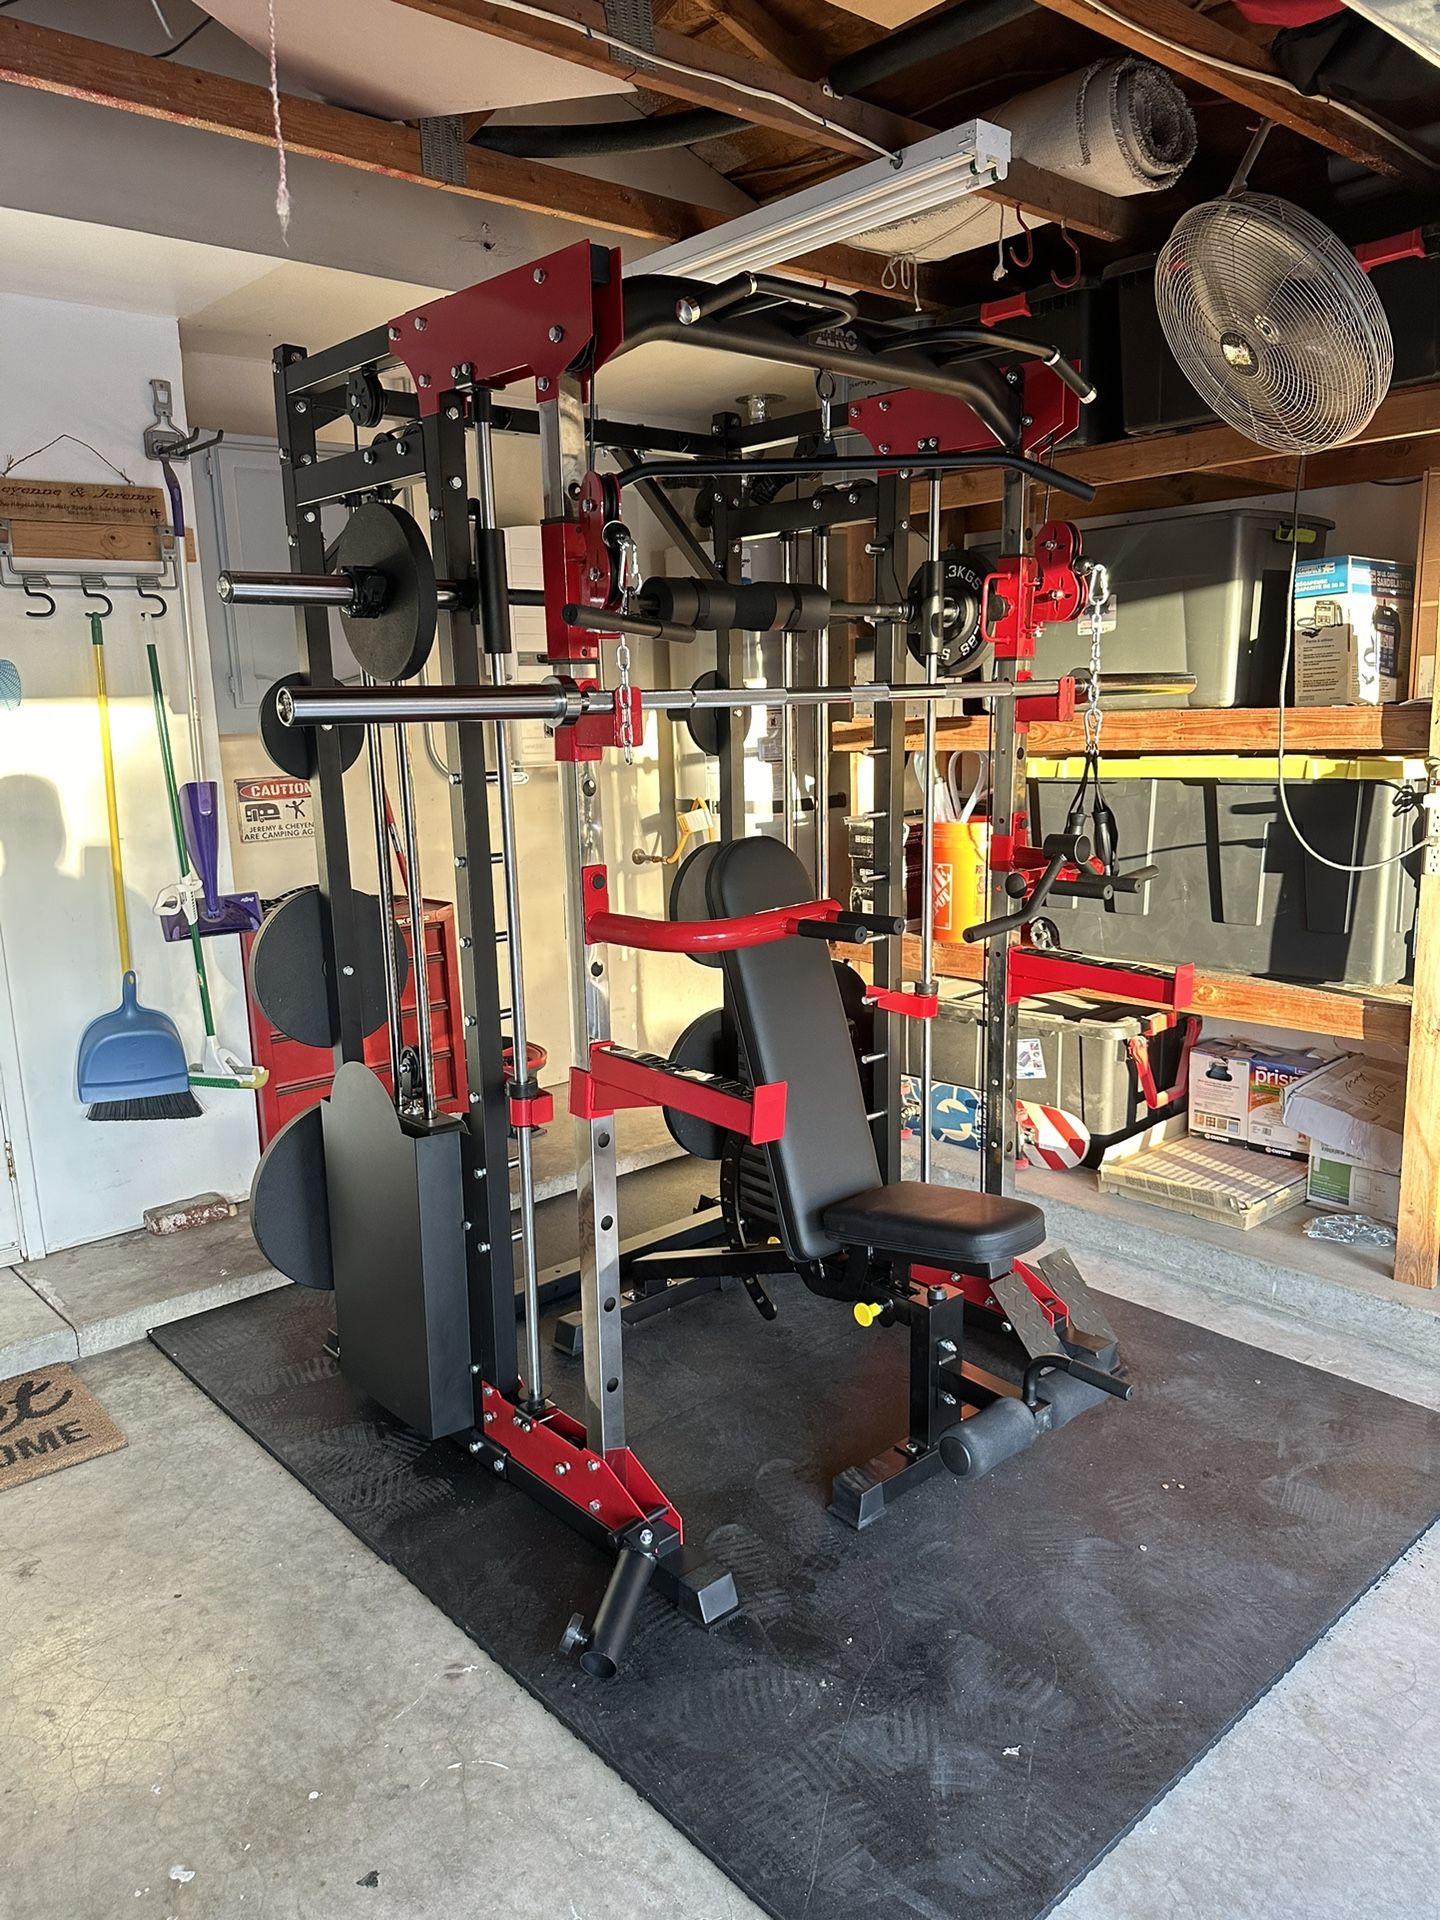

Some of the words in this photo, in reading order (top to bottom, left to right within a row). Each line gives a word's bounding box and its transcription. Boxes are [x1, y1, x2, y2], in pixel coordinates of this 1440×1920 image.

[70, 486, 86, 498] &
[93, 488, 156, 503] Jeremy
[250, 782, 311, 797] CAUTION
[244, 832, 259, 840] ARE
[262, 829, 300, 839] CAMPING
[249, 825, 277, 833] JEREMY
